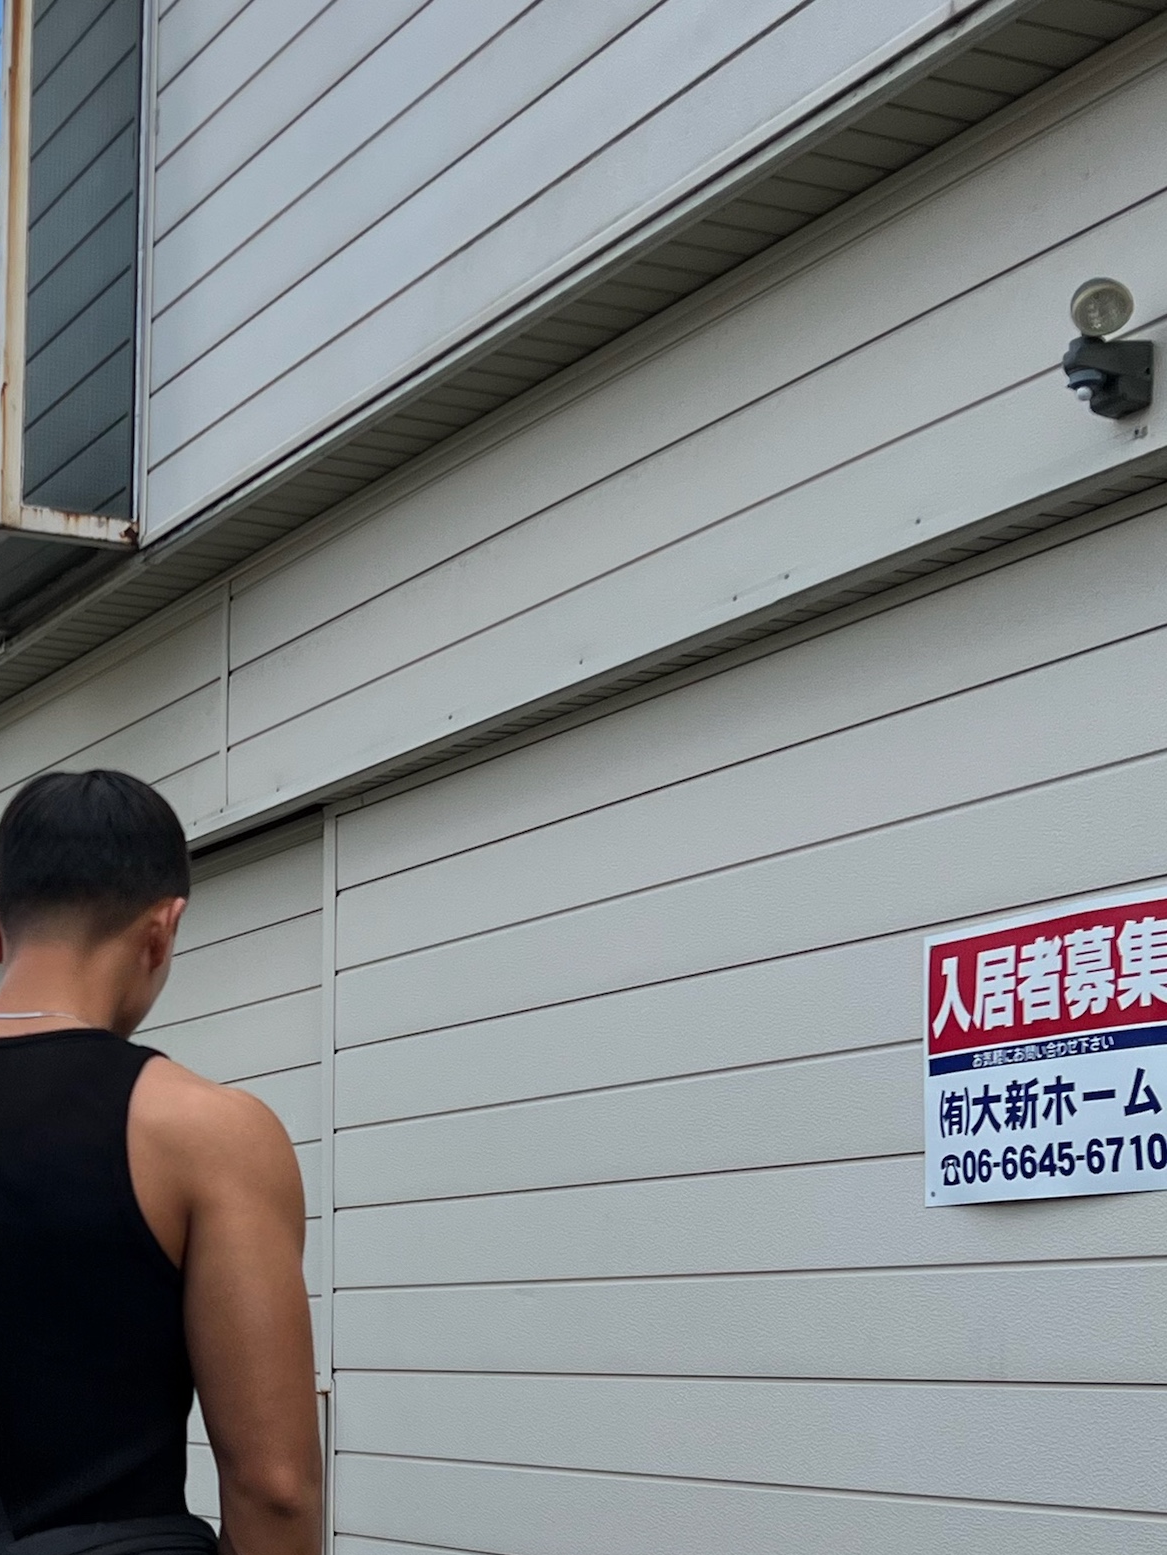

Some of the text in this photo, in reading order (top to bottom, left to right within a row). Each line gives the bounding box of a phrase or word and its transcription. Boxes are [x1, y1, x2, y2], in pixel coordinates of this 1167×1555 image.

[932, 916, 1167, 1039] 入居者募集
[972, 1035, 1114, 1068] お気軽にお問い合わせ下さい
[962, 1133, 1167, 1184] 06-6645-6710
